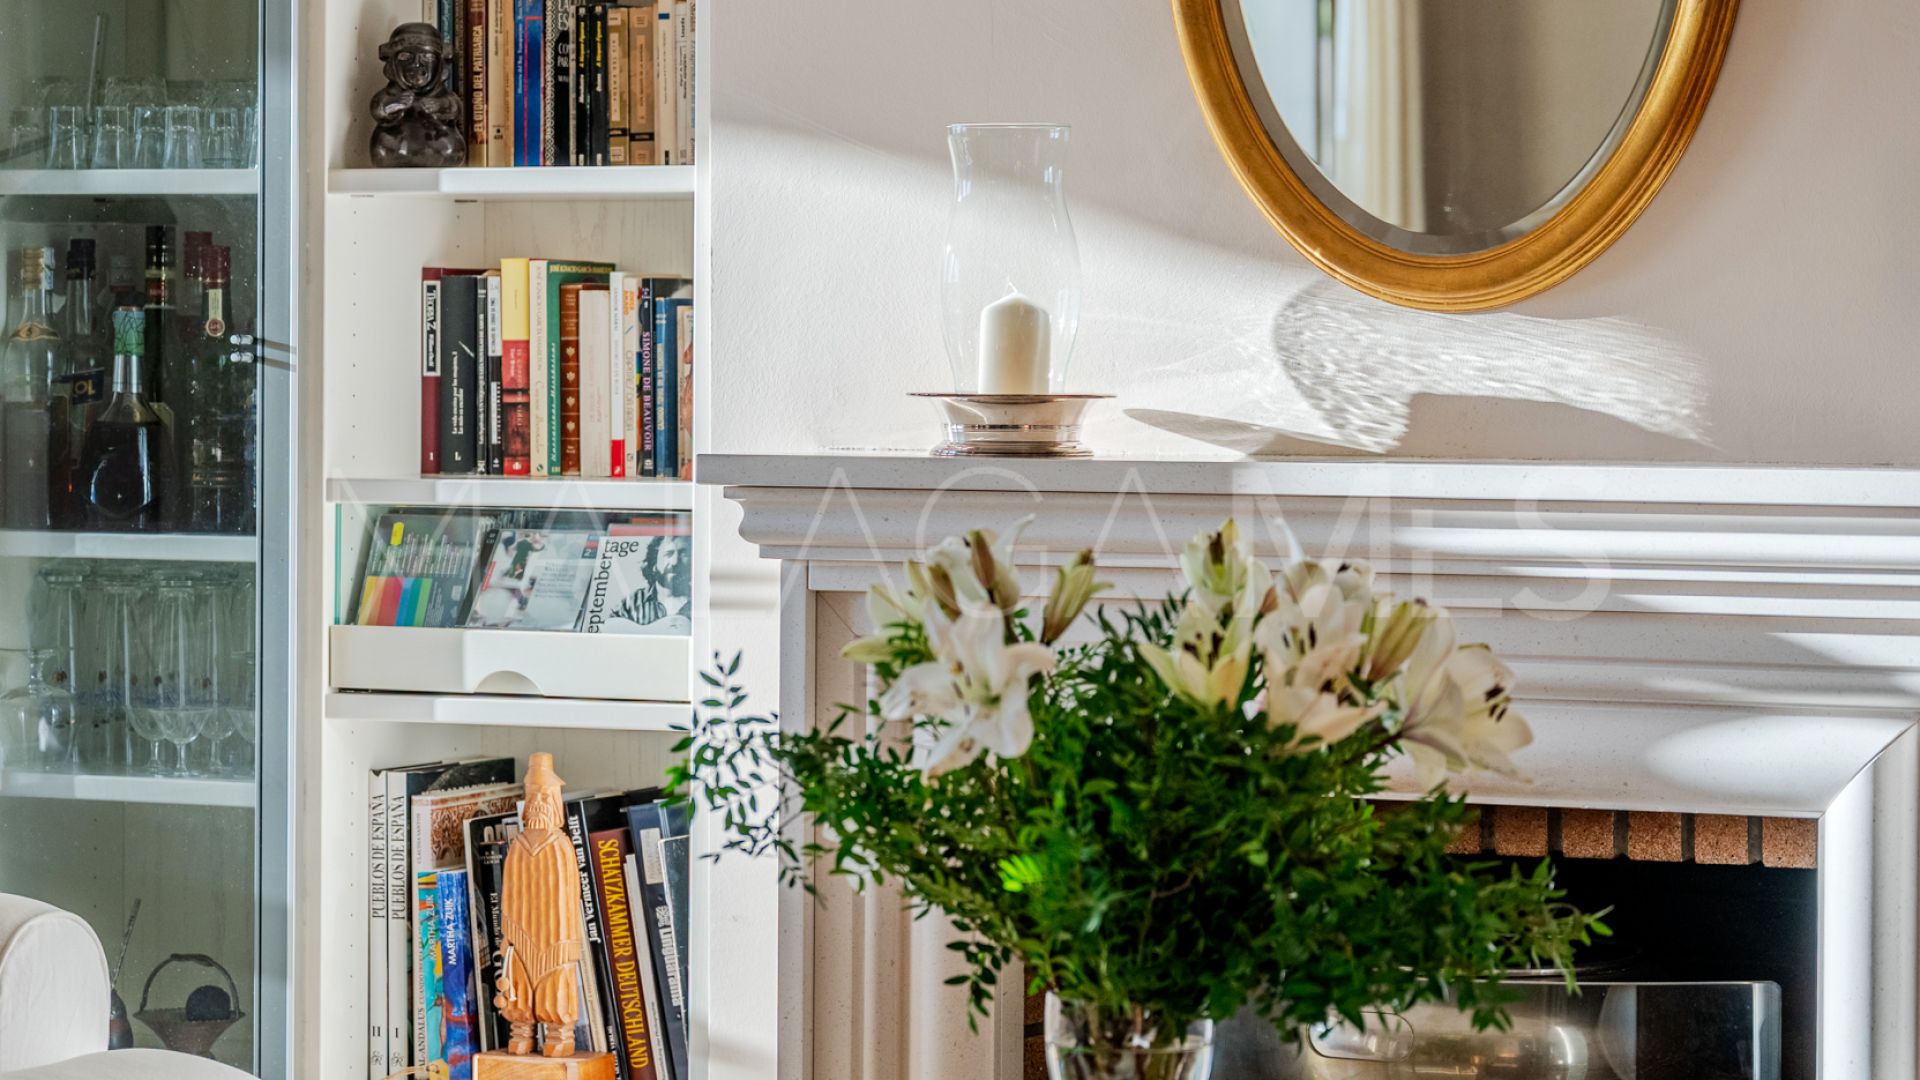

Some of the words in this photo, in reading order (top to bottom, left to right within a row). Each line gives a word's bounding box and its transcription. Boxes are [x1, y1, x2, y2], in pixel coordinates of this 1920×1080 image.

[473, 25, 482, 71] PATRIARCA
[473, 73, 482, 89] DEL
[472, 91, 483, 121] OTOÑO
[474, 122, 483, 132] EL
[642, 331, 651, 373] SIMONE
[643, 377, 651, 391] DE
[643, 395, 652, 451] BEAUVOIR
[605, 540, 639, 557] tage
[369, 794, 385, 840] ESPAÑA
[388, 795, 404, 842] ESPAÑA
[568, 815, 583, 846] Delft
[371, 843, 384, 860] DE
[391, 845, 404, 862] DE
[575, 848, 586, 869] van
[371, 862, 385, 918] PUEBLOS
[391, 864, 405, 920] PUEBLOS
[425, 894, 435, 916] ZUIK
[490, 892, 498, 903] El
[579, 871, 595, 920] Vermeer
[598, 838, 629, 957] SCHATZKAMMER
[444, 898, 454, 921] ZUIK
[491, 905, 501, 935] Mundo
[426, 919, 436, 961] MARTHA
[446, 922, 457, 965] MARTHA
[586, 921, 601, 944] Jan
[613, 960, 648, 1069] DEUTSCHLAND
